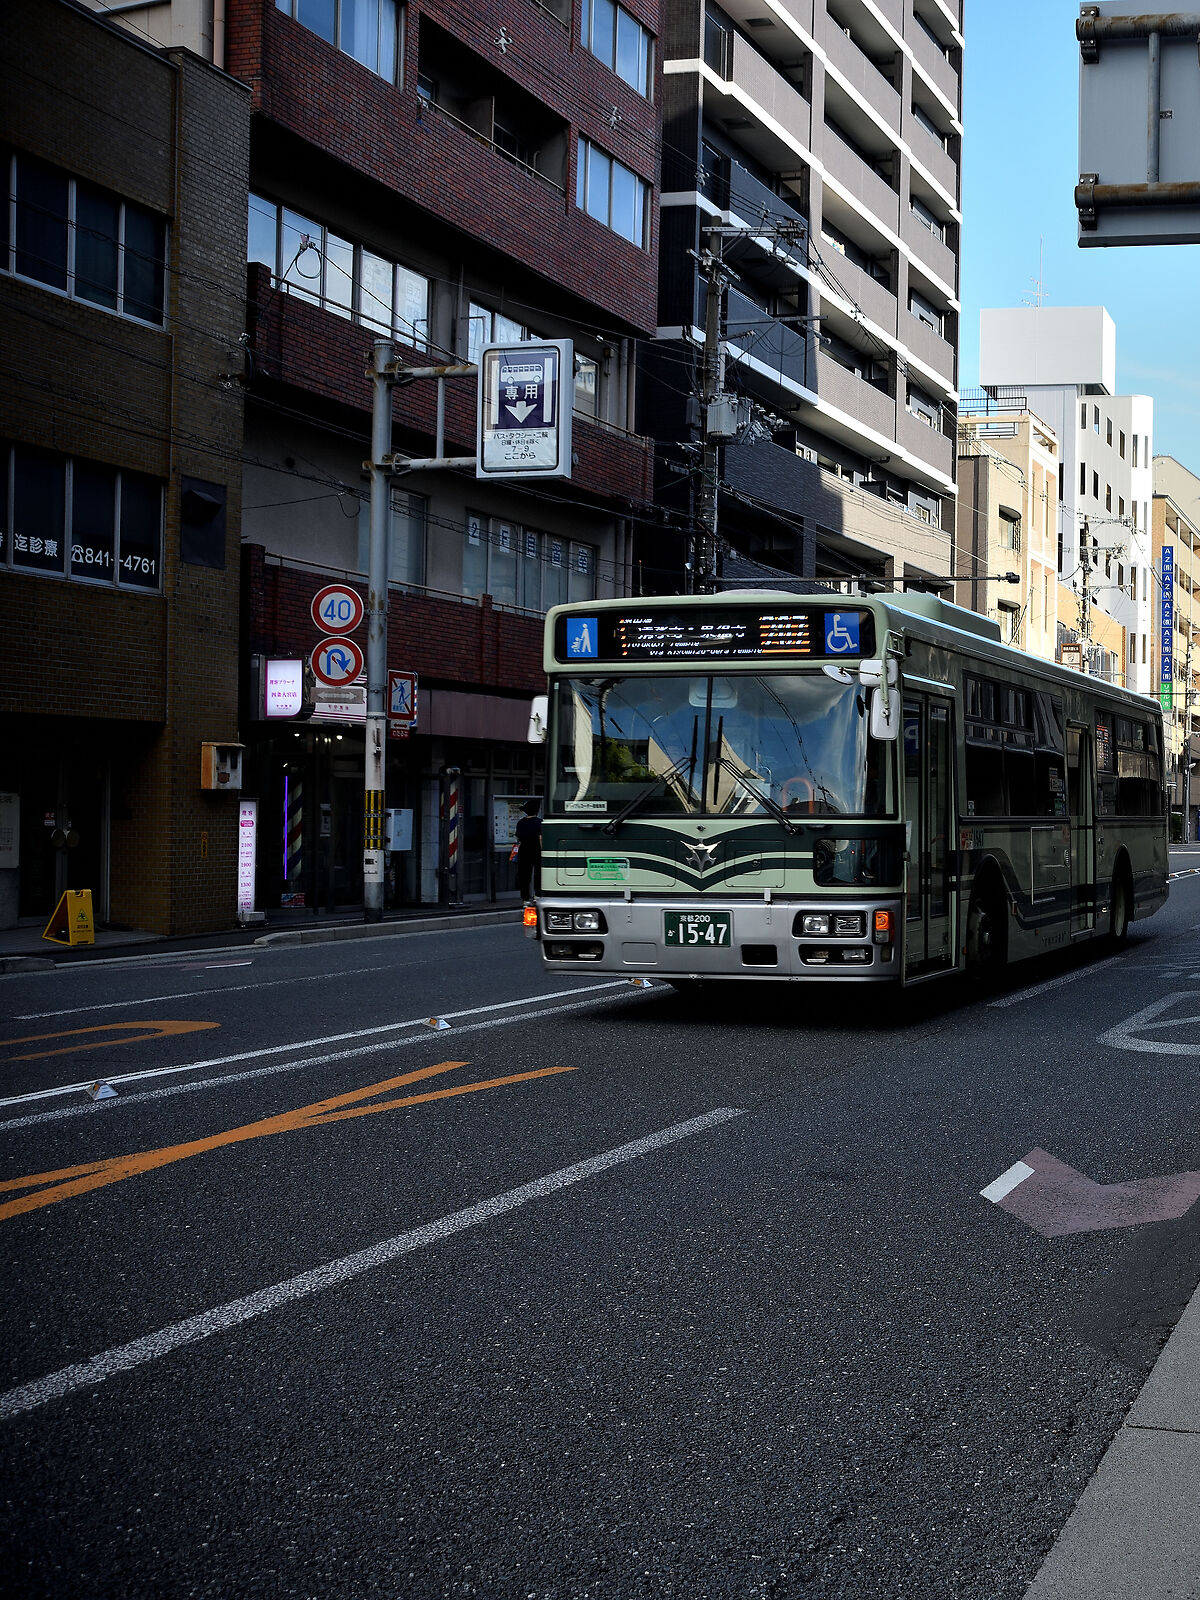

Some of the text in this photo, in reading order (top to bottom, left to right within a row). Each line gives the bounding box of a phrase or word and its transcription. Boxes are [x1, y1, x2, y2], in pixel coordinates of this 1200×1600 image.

[505, 384, 538, 400] 専用
[504, 452, 537, 460] ここから
[324, 599, 351, 621] 40
[679, 923, 728, 944] 15-47
